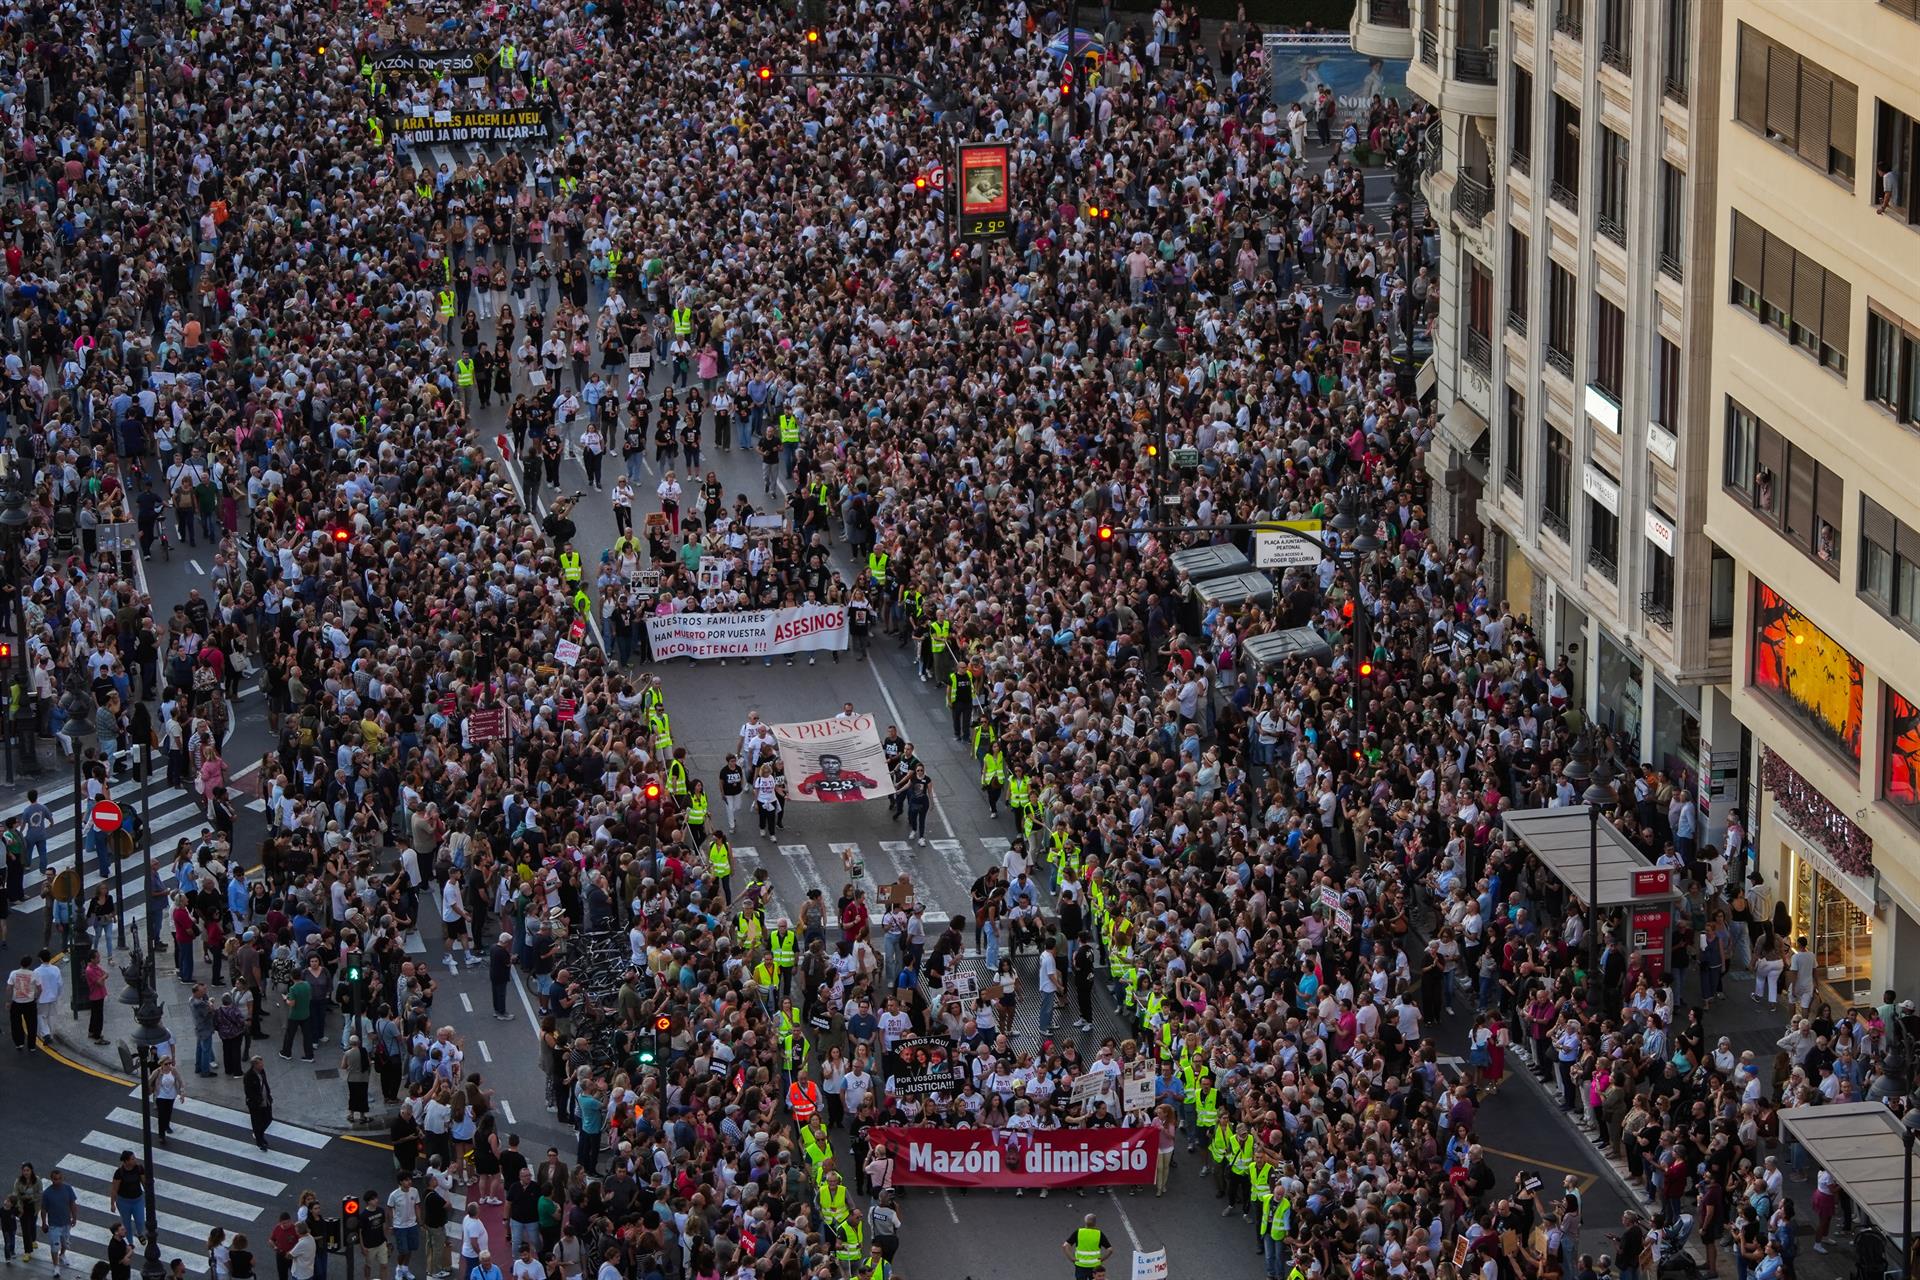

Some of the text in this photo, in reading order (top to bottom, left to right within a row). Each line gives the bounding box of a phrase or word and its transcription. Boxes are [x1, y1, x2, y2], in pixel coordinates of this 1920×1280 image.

[402, 117, 425, 130] ARA
[465, 113, 500, 126] ALCEM
[503, 113, 516, 125] LA
[416, 131, 434, 142] QUI
[436, 129, 450, 141] JA
[453, 128, 468, 140] NO
[471, 127, 491, 139] POT
[494, 124, 548, 141] ALÇAR-LA
[652, 614, 766, 629] NUESTROS FAMILIARES
[774, 611, 844, 642] ASESINOS
[654, 628, 766, 642] HAN MUERTO POR VUESTRA
[656, 642, 749, 657] INCOMPETENCIA
[820, 780, 854, 791] 228
[944, 971, 975, 981] JUSTICIA
[894, 1038, 949, 1055] ESTAMOS AQUÍ
[896, 1072, 952, 1084] POR VOSOTROS
[909, 1140, 1147, 1173] Mazón dimissió
